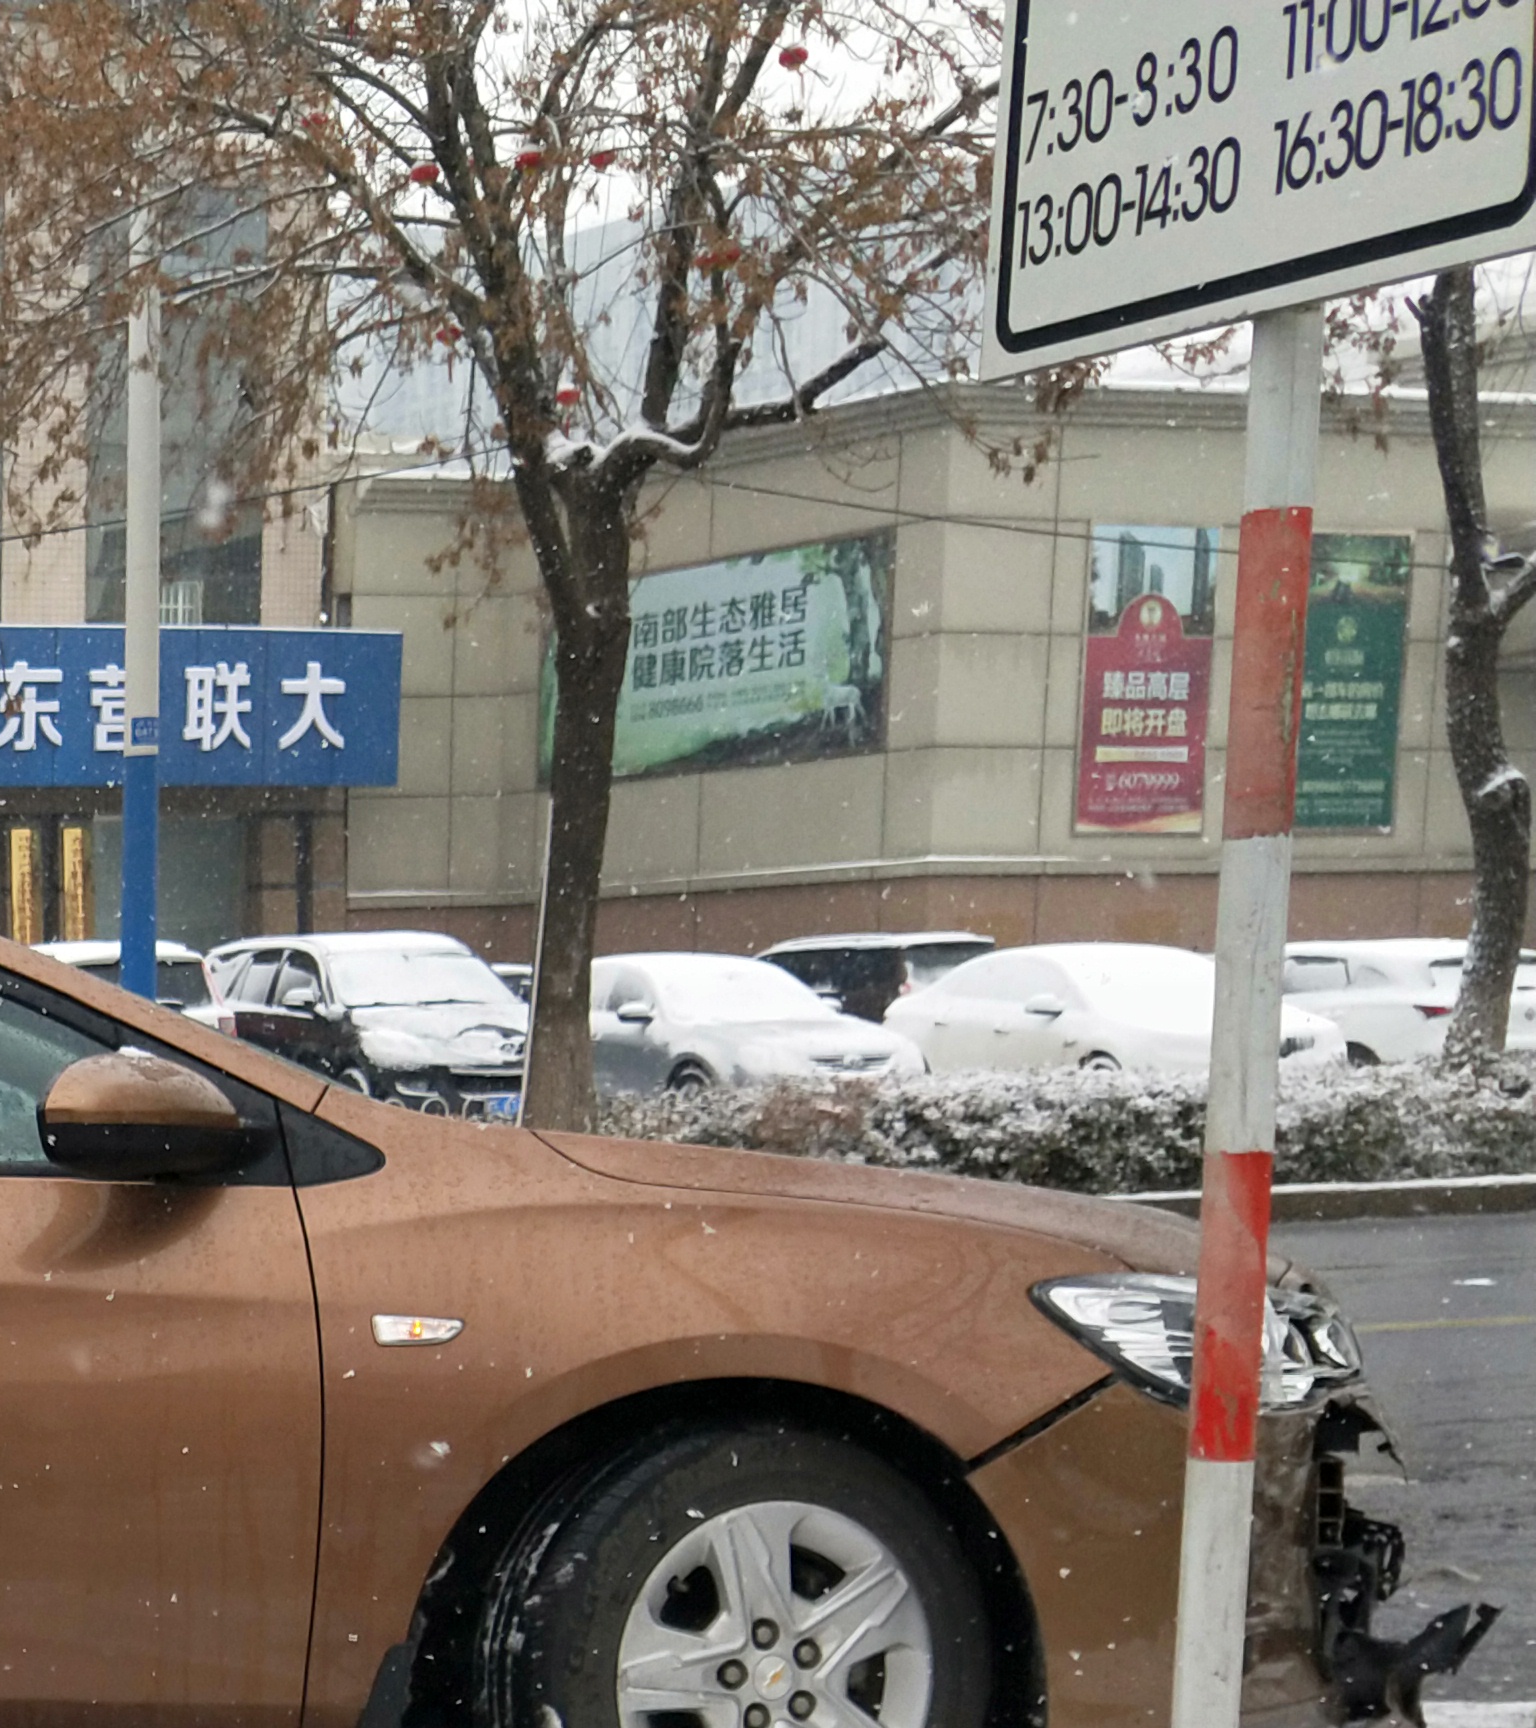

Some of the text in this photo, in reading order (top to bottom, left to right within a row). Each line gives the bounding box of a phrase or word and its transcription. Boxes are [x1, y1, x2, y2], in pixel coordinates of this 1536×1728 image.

[1018, 47, 1522, 269] 13:00-14:30 16:30-18:30
[632, 585, 808, 650] 南部生态雅居
[632, 628, 807, 692] 健康院落生活
[1101, 707, 1188, 738] 即将开盘
